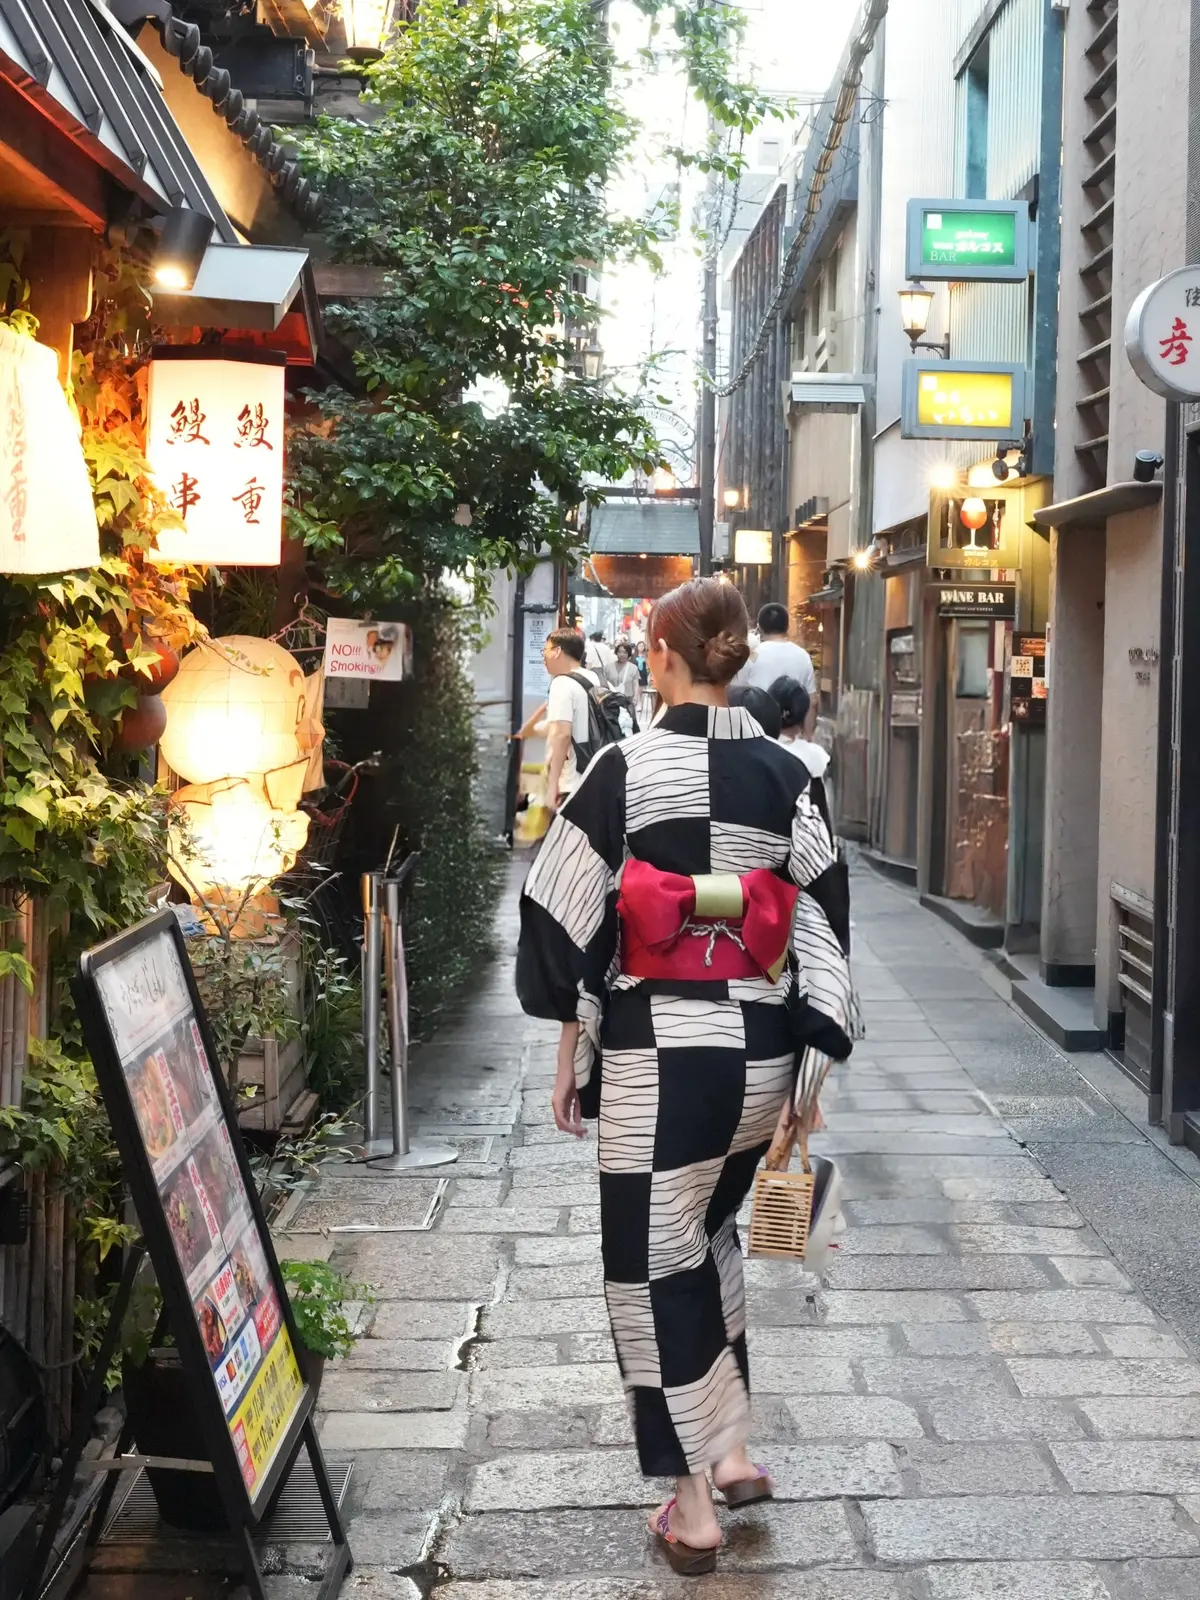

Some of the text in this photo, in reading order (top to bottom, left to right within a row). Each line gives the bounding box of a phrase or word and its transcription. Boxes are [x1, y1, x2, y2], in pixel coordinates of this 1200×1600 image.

[930, 250, 956, 262] BAR
[232, 402, 273, 524] 鰻重
[940, 589, 1004, 603] WINE BAR
[331, 643, 361, 656] NO!!!
